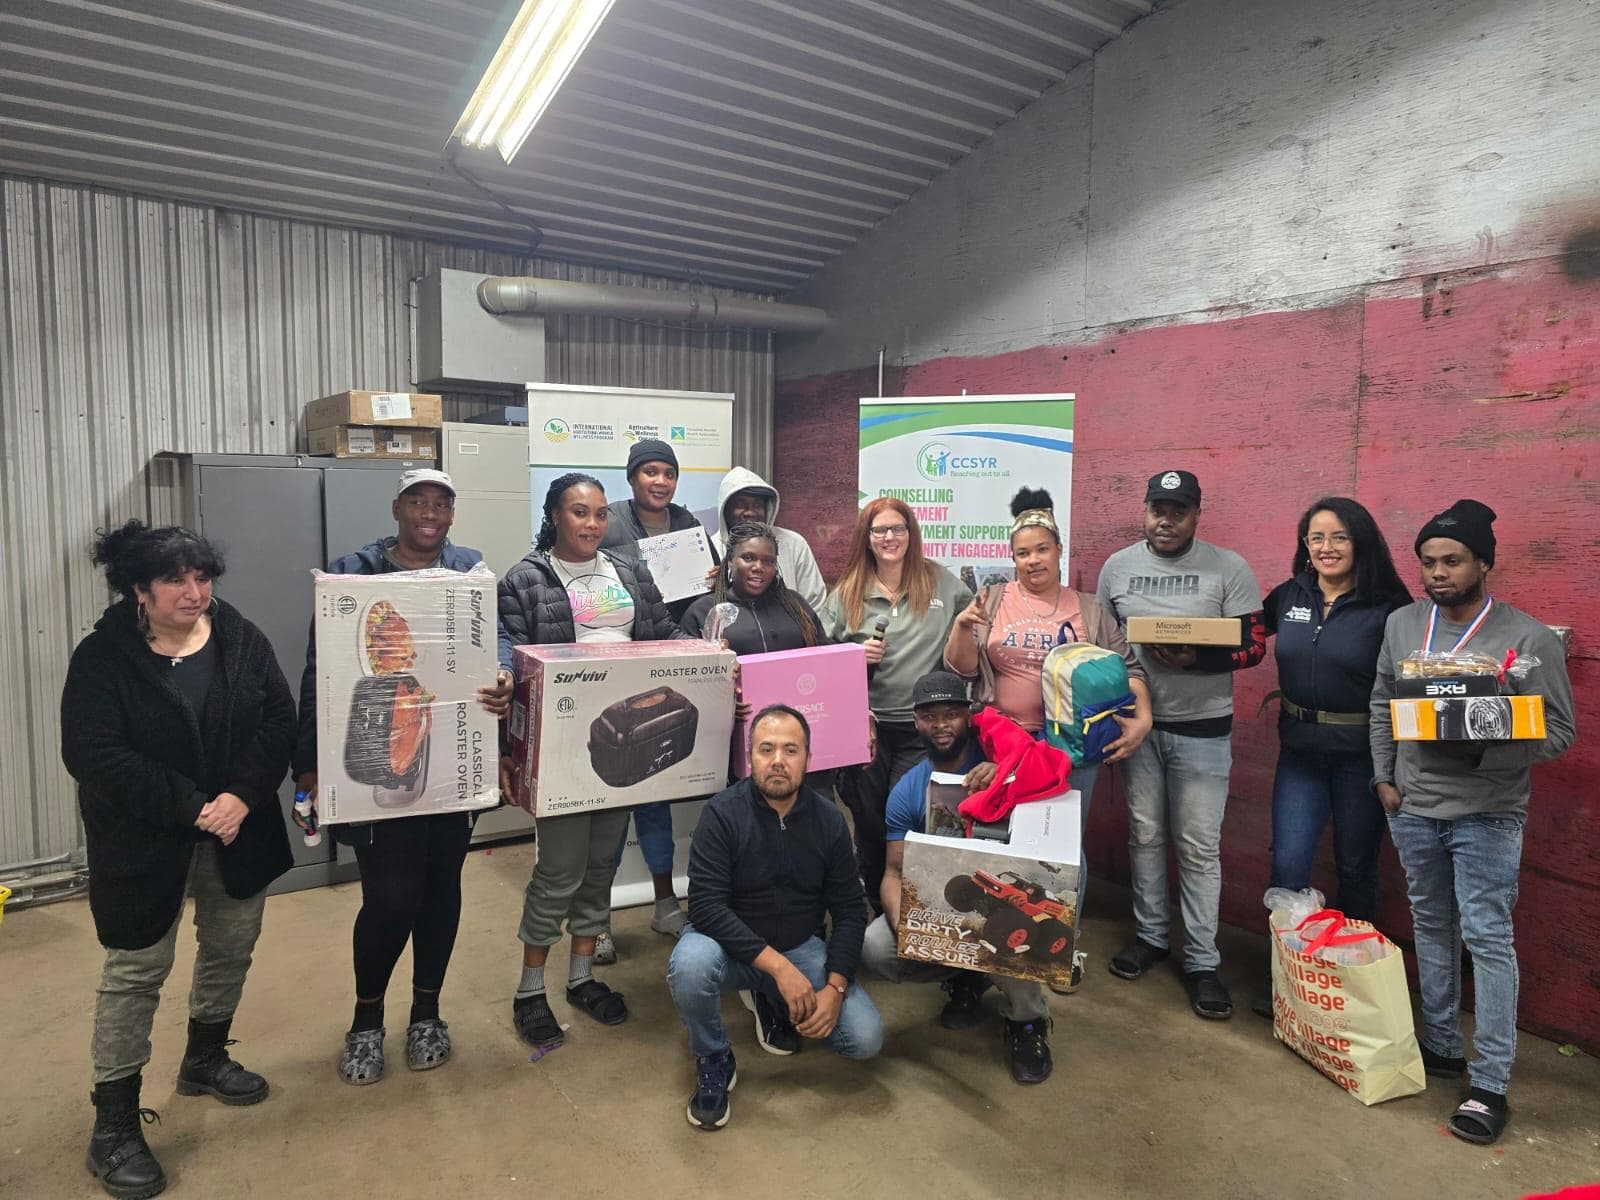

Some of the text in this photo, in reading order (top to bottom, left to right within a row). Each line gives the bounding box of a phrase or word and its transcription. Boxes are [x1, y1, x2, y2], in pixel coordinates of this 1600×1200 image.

[951, 457, 998, 468] CCSYR
[880, 488, 953, 503] COUNSELLING
[951, 543, 1013, 558] ENGAGEME
[1127, 574, 1199, 595] PUMA
[1155, 621, 1192, 630] Microsoft
[1002, 632, 1054, 650] AER
[650, 664, 728, 678] ROASTER OVEN
[1425, 684, 1467, 696] AXE
[456, 702, 468, 800] ROASTER OVEN
[472, 730, 483, 799] CLASSICAL
[907, 908, 966, 927] DRIVE
[906, 919, 972, 940] DIRTY
[905, 932, 981, 956] ROULEZ
